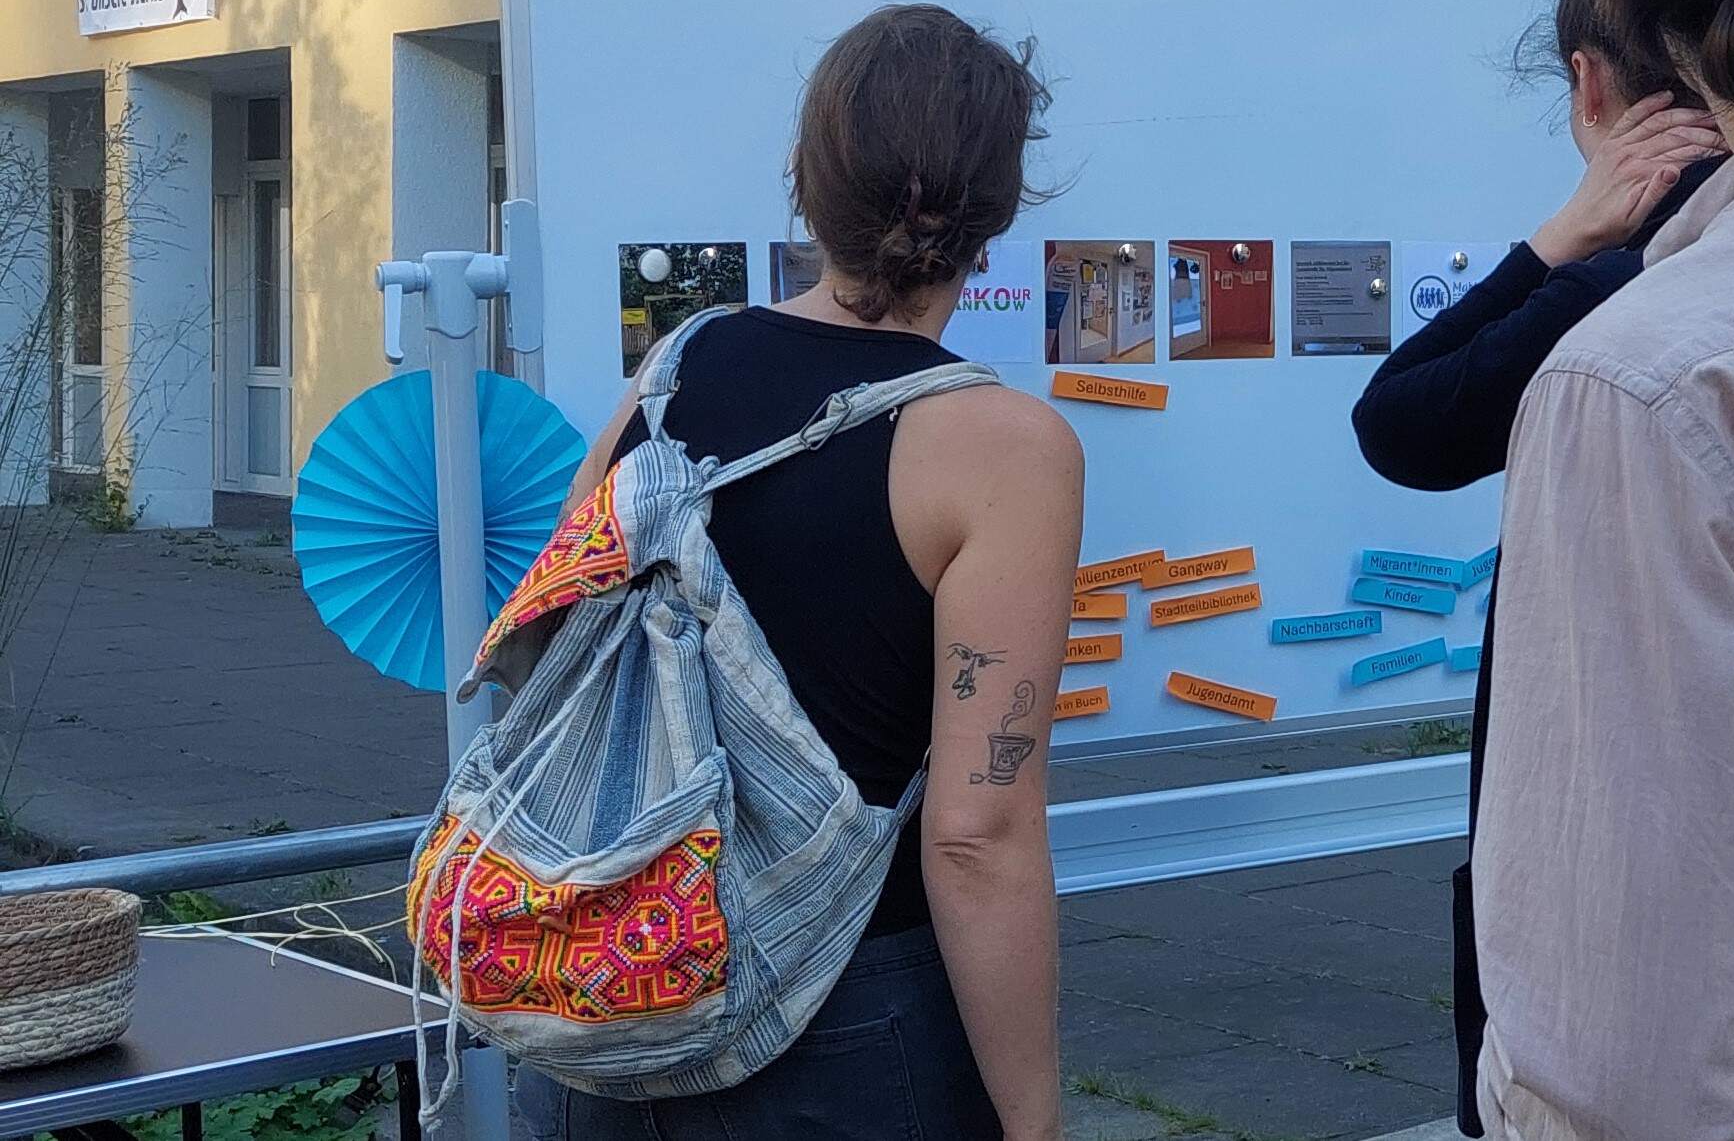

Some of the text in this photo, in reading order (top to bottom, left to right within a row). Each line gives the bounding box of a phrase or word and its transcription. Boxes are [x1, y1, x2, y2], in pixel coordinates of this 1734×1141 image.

[1076, 379, 1147, 401] Selbsthilfe
[1168, 558, 1229, 578] Gangway
[1155, 590, 1257, 619] Stadtteilbibliothek
[1384, 587, 1424, 603] Kinder
[1280, 616, 1375, 637] Nachbarschaft
[1371, 651, 1423, 675] Familien
[1186, 682, 1256, 711] Jugendamt
